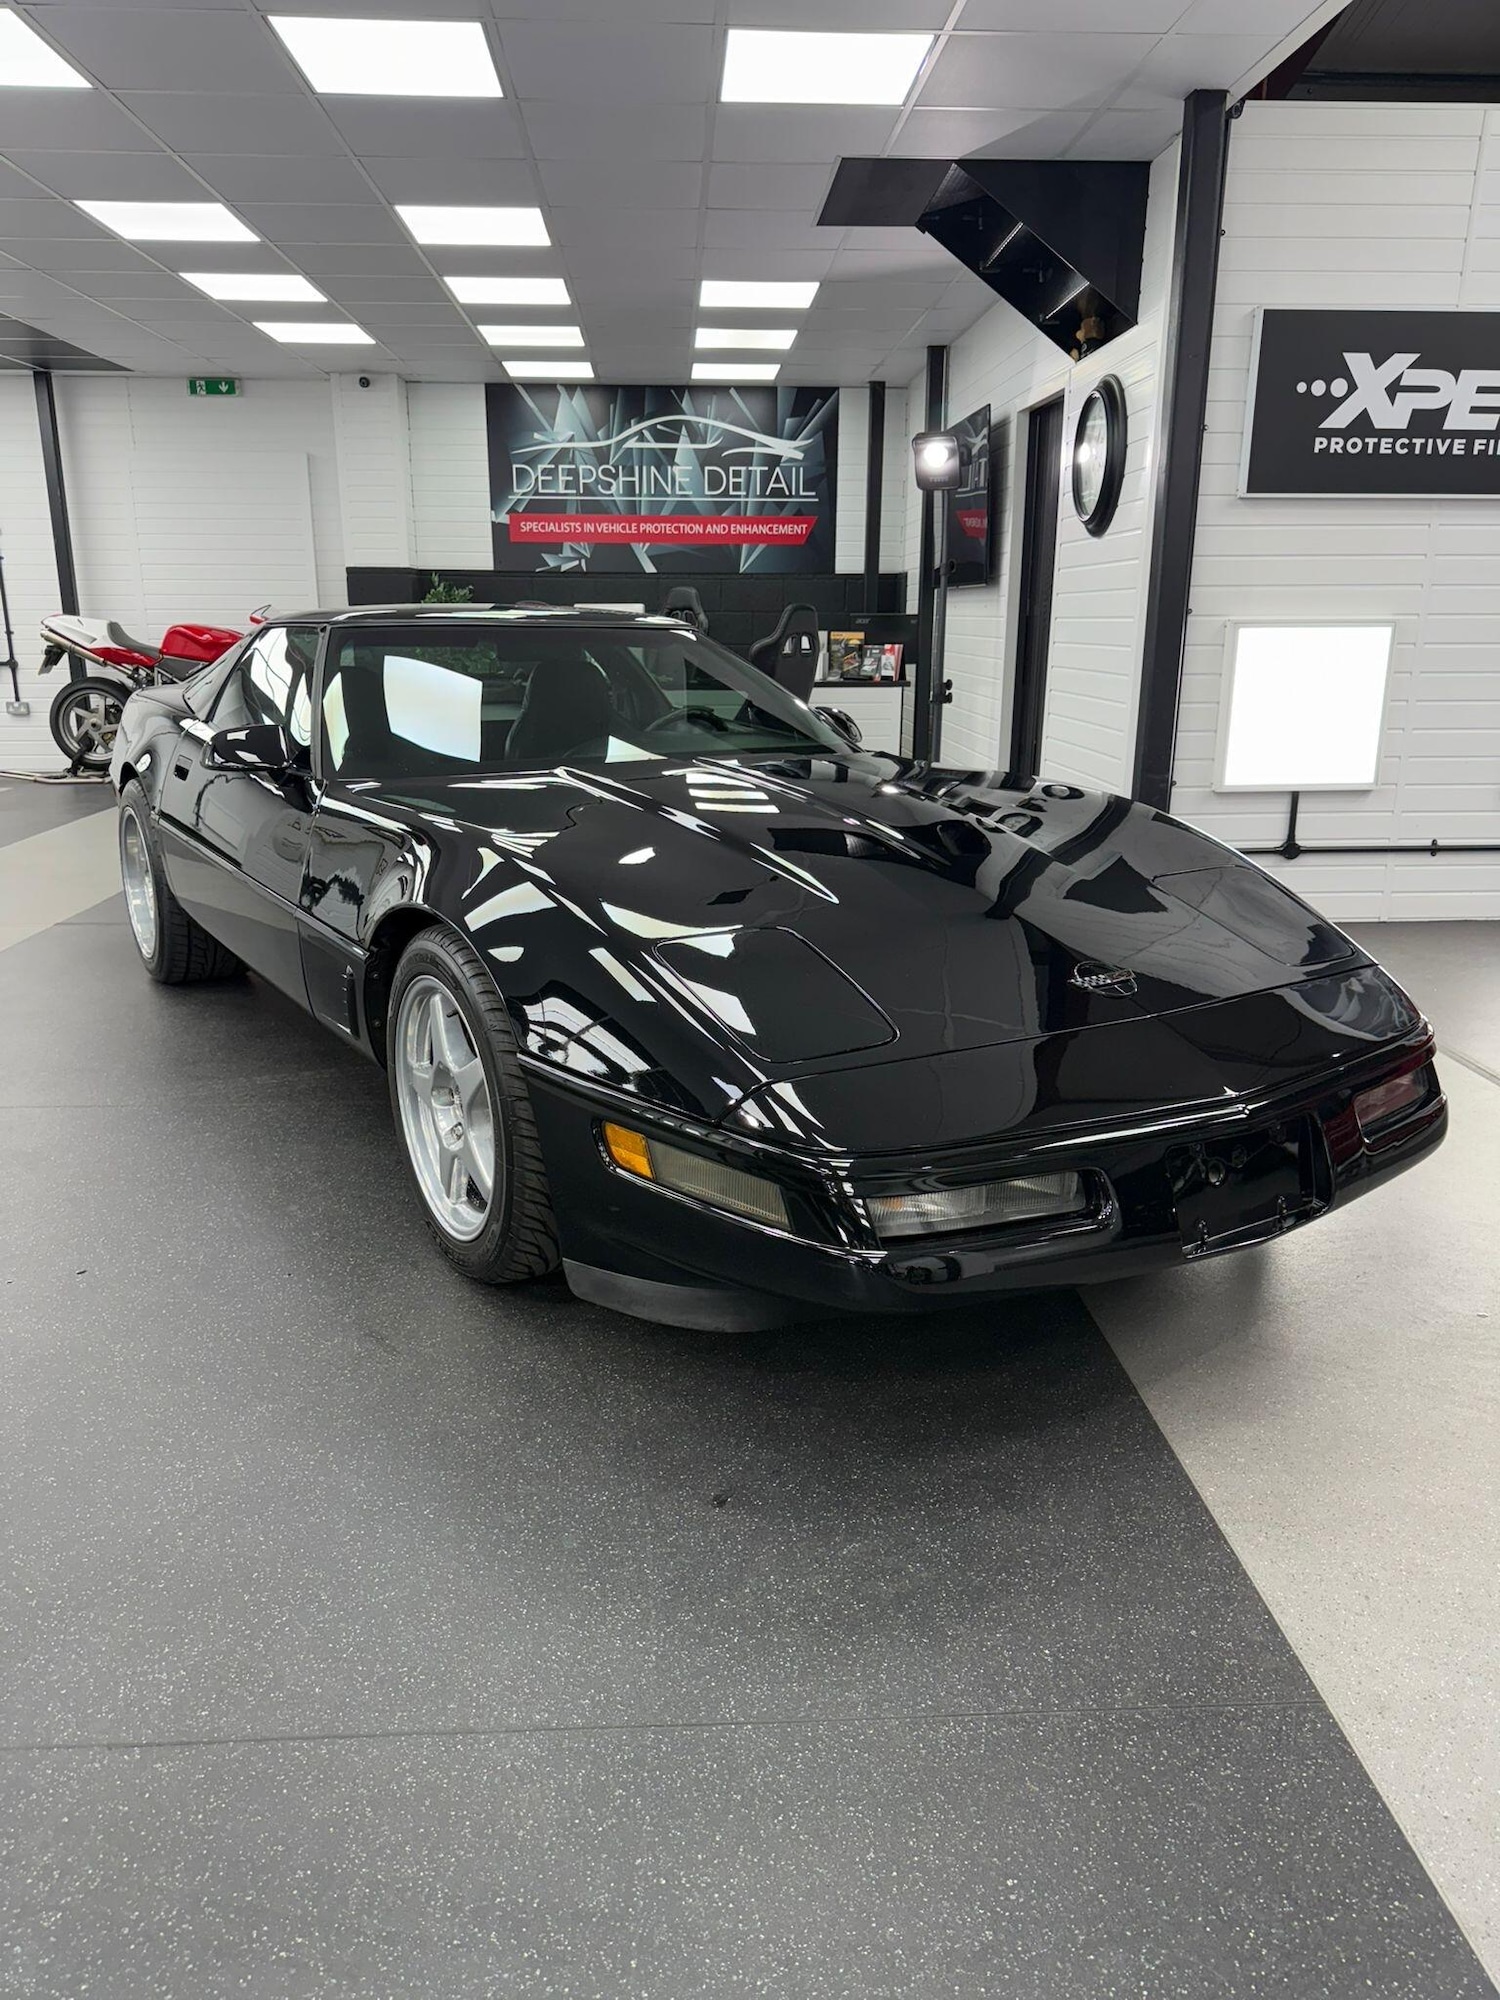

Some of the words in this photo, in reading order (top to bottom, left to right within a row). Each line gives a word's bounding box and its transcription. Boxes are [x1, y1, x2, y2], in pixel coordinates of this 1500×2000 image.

[1313, 437, 1465, 455] PROTECTIVE
[512, 464, 693, 495] DEEPSHINE
[704, 465, 817, 496] DETAIL
[520, 521, 581, 533] SPECIALISTS
[583, 522, 595, 533] IN
[595, 522, 638, 534] VEHICLE
[639, 522, 703, 534] PROTECTION
[705, 523, 729, 535] AND
[730, 523, 808, 535] ENHANCEMENT
